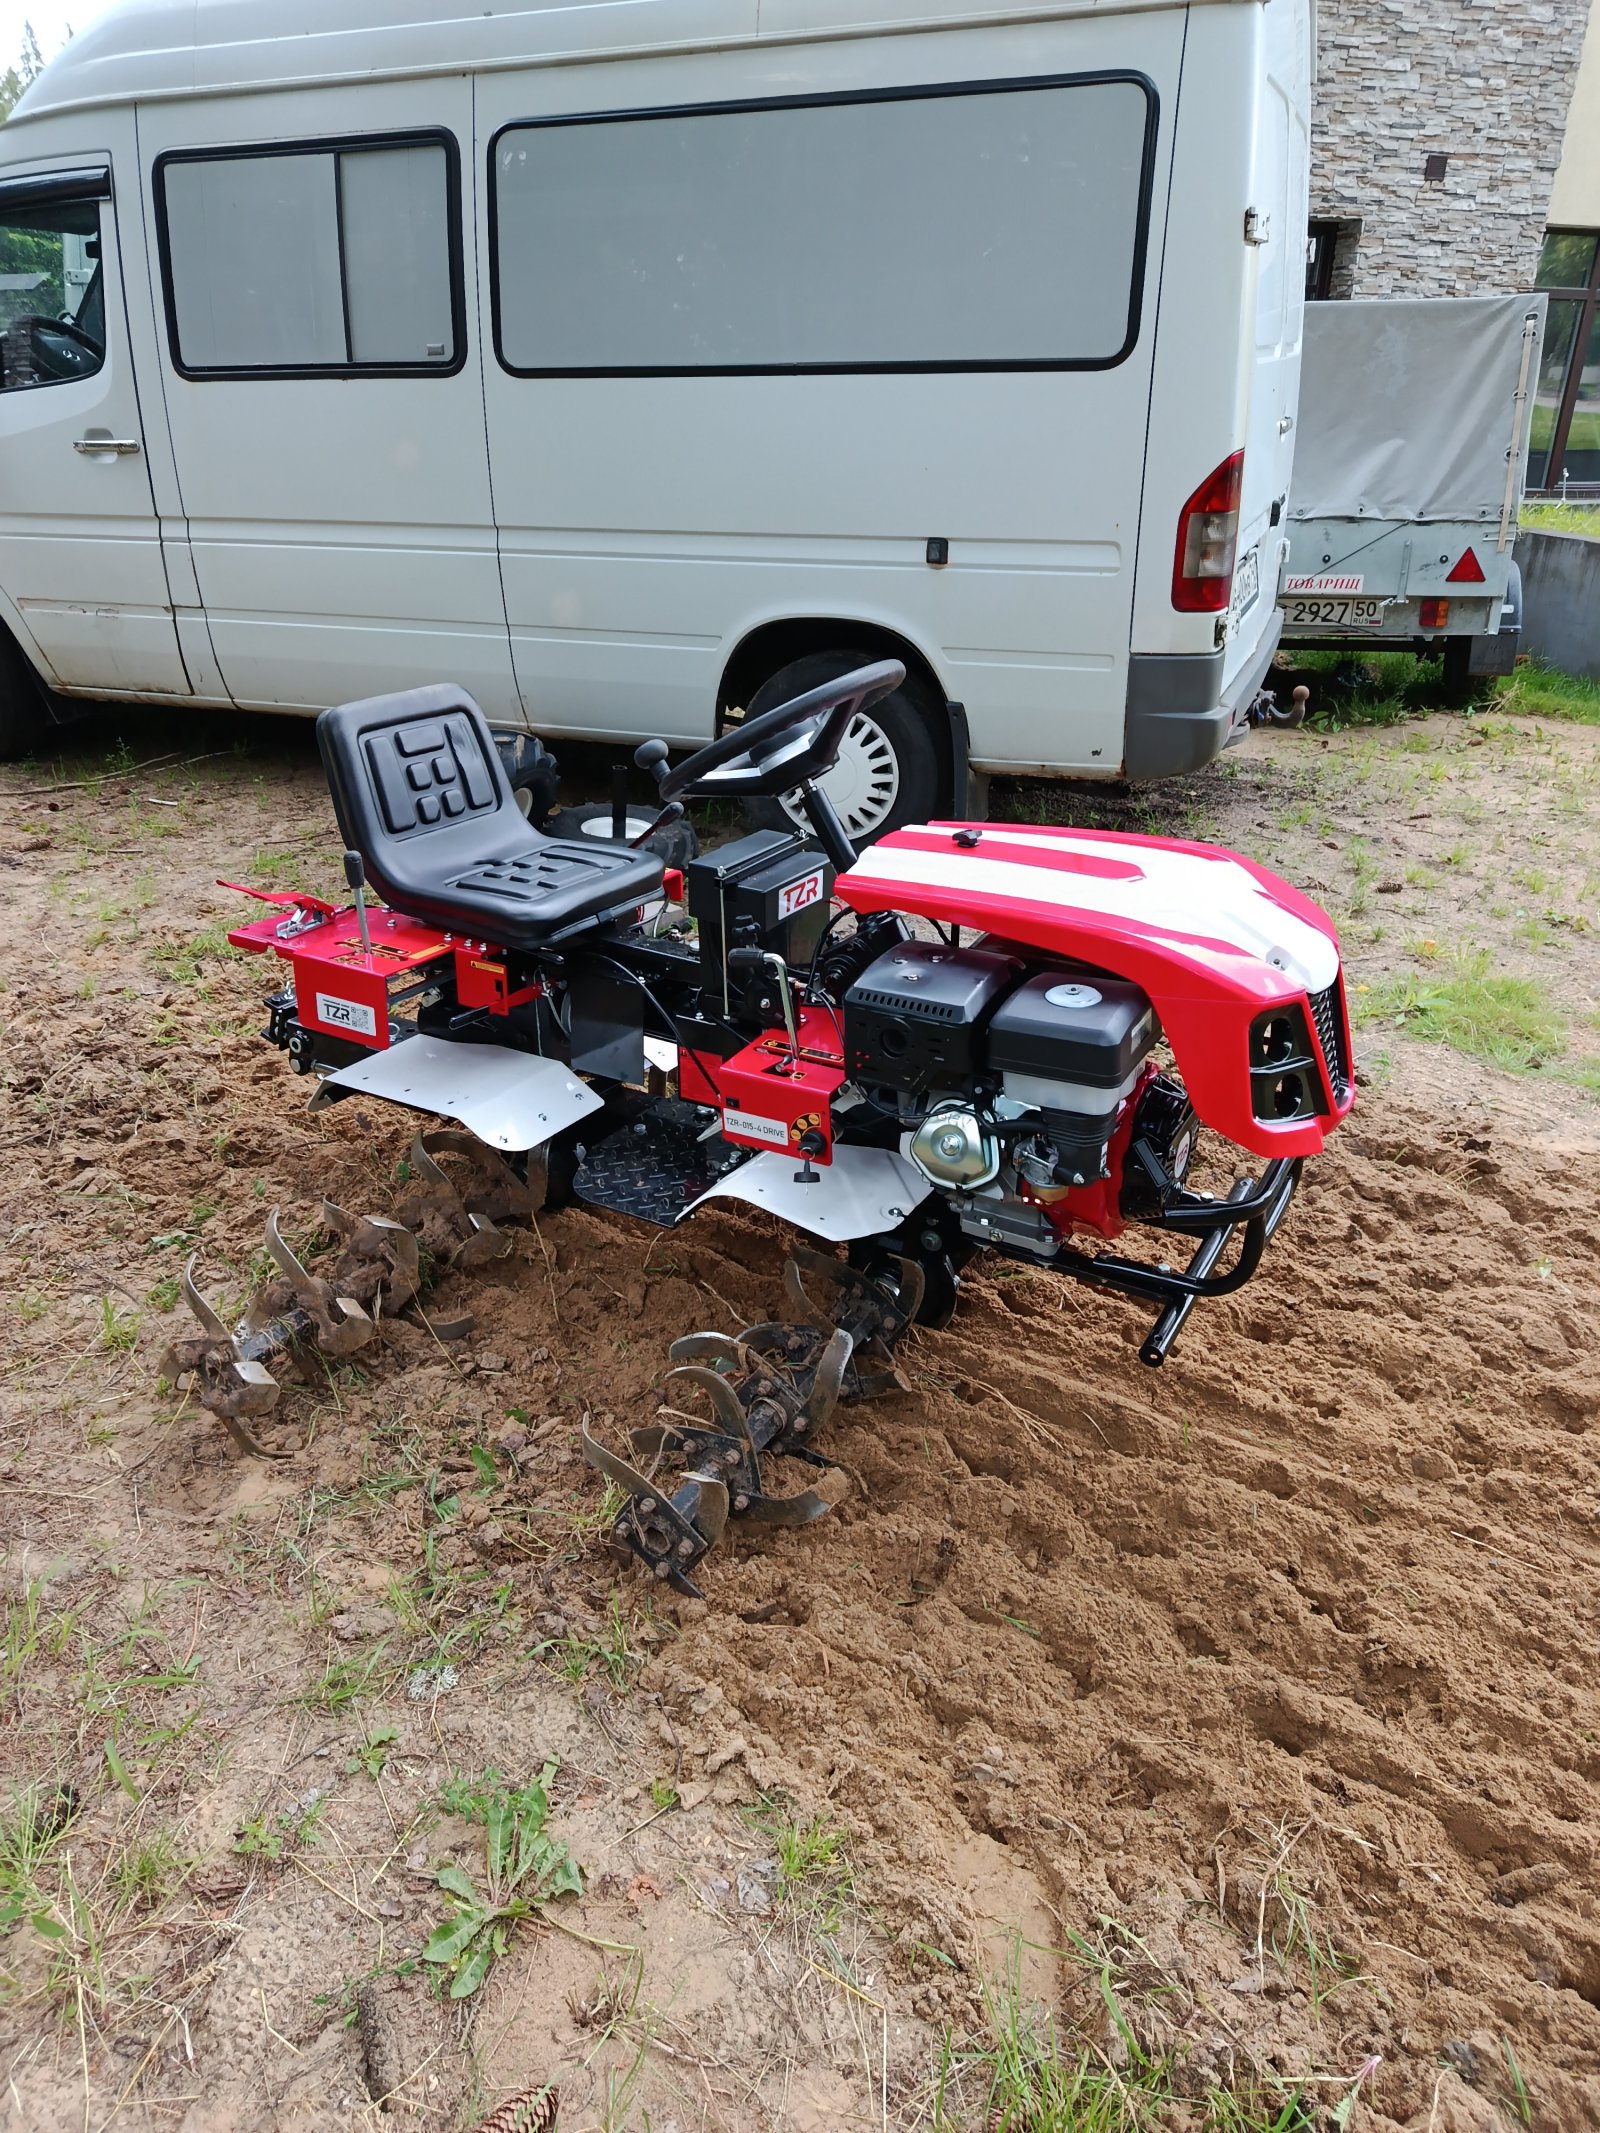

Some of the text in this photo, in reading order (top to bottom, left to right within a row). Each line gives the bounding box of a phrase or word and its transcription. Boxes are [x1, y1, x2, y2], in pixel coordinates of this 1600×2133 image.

[1287, 578, 1361, 591] ТОВАРИЩ
[1293, 601, 1377, 623] 2927 50
[783, 876, 819, 913] TZR
[323, 1003, 350, 1022] TZR
[726, 1117, 762, 1133] TZR-015-4
[763, 1126, 785, 1139] DRIVE
